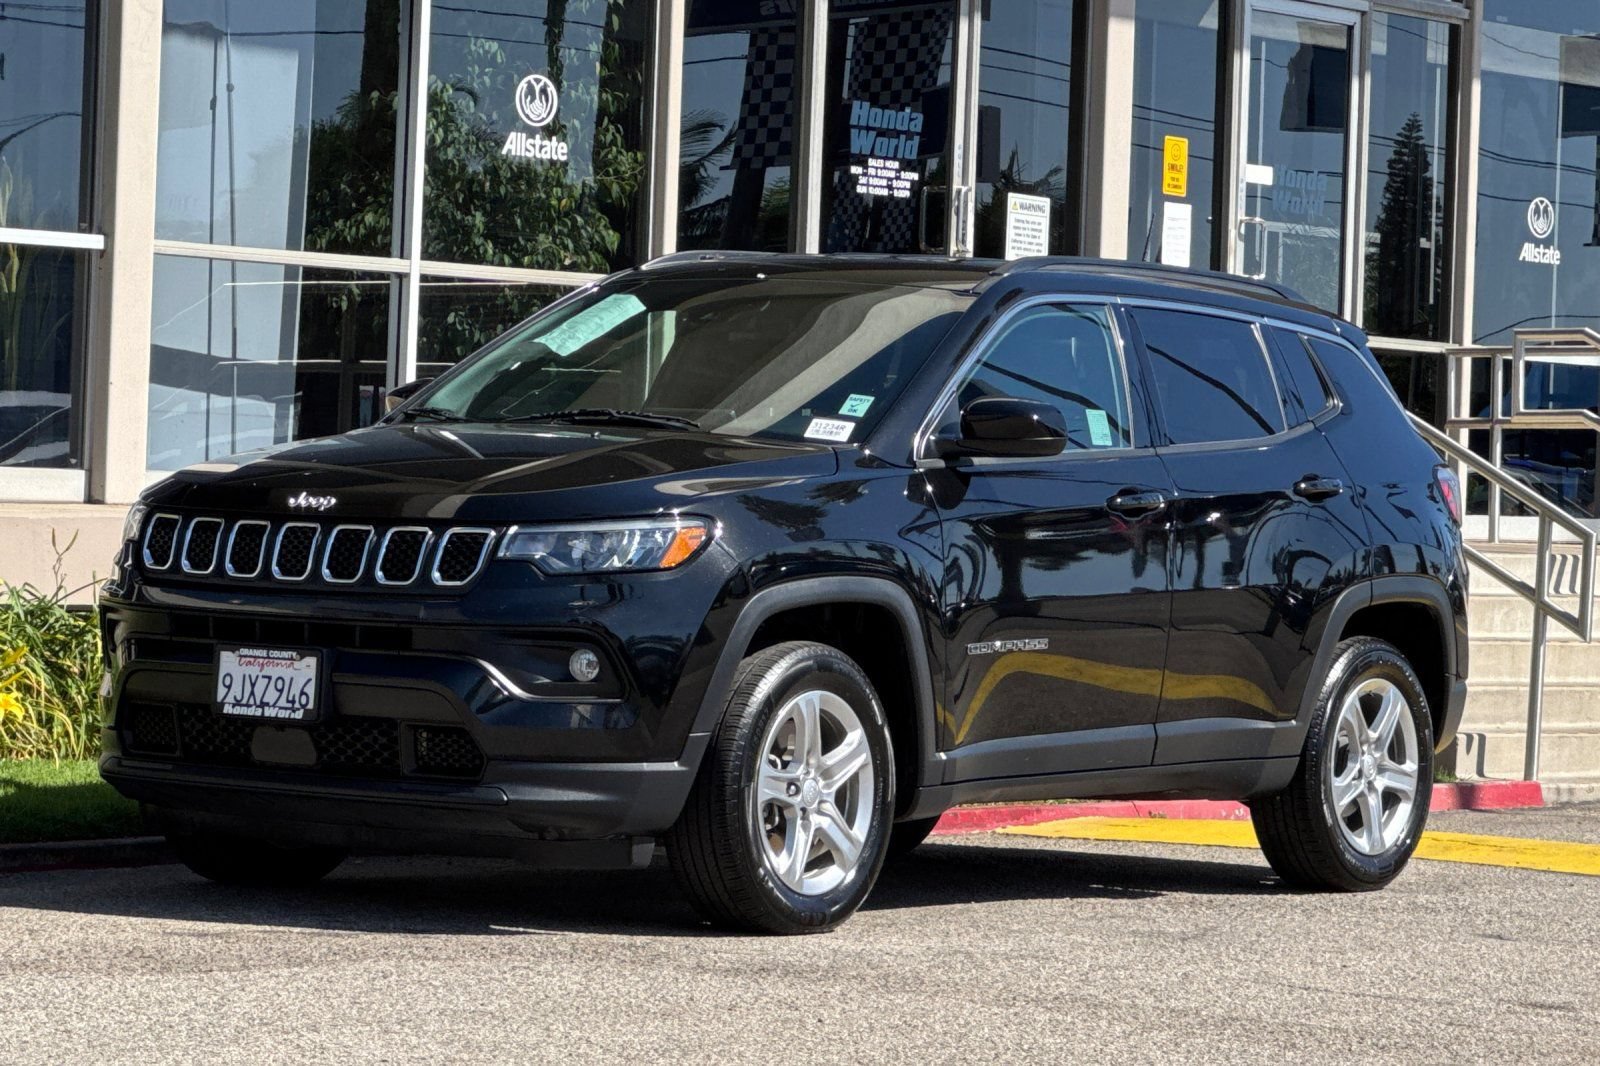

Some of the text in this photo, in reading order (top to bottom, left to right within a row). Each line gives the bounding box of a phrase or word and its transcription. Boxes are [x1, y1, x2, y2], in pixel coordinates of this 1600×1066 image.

[849, 100, 924, 133] Honda
[501, 131, 568, 161] Allstate
[850, 128, 920, 160] World
[850, 165, 863, 174] MON
[868, 167, 876, 176] FRI
[868, 158, 899, 169] SALES HOUR
[858, 175, 868, 184] SAT
[856, 184, 867, 194] SUN
[1019, 201, 1046, 214] WARNING
[1519, 242, 1561, 265] Allstate
[287, 491, 336, 511] Jeep
[239, 648, 298, 658] ORANGE COUNTY
[967, 638, 1049, 655] COMPASS
[238, 657, 297, 672] California
[222, 672, 312, 709] 9JXZ946
[223, 704, 304, 719] Honda World
